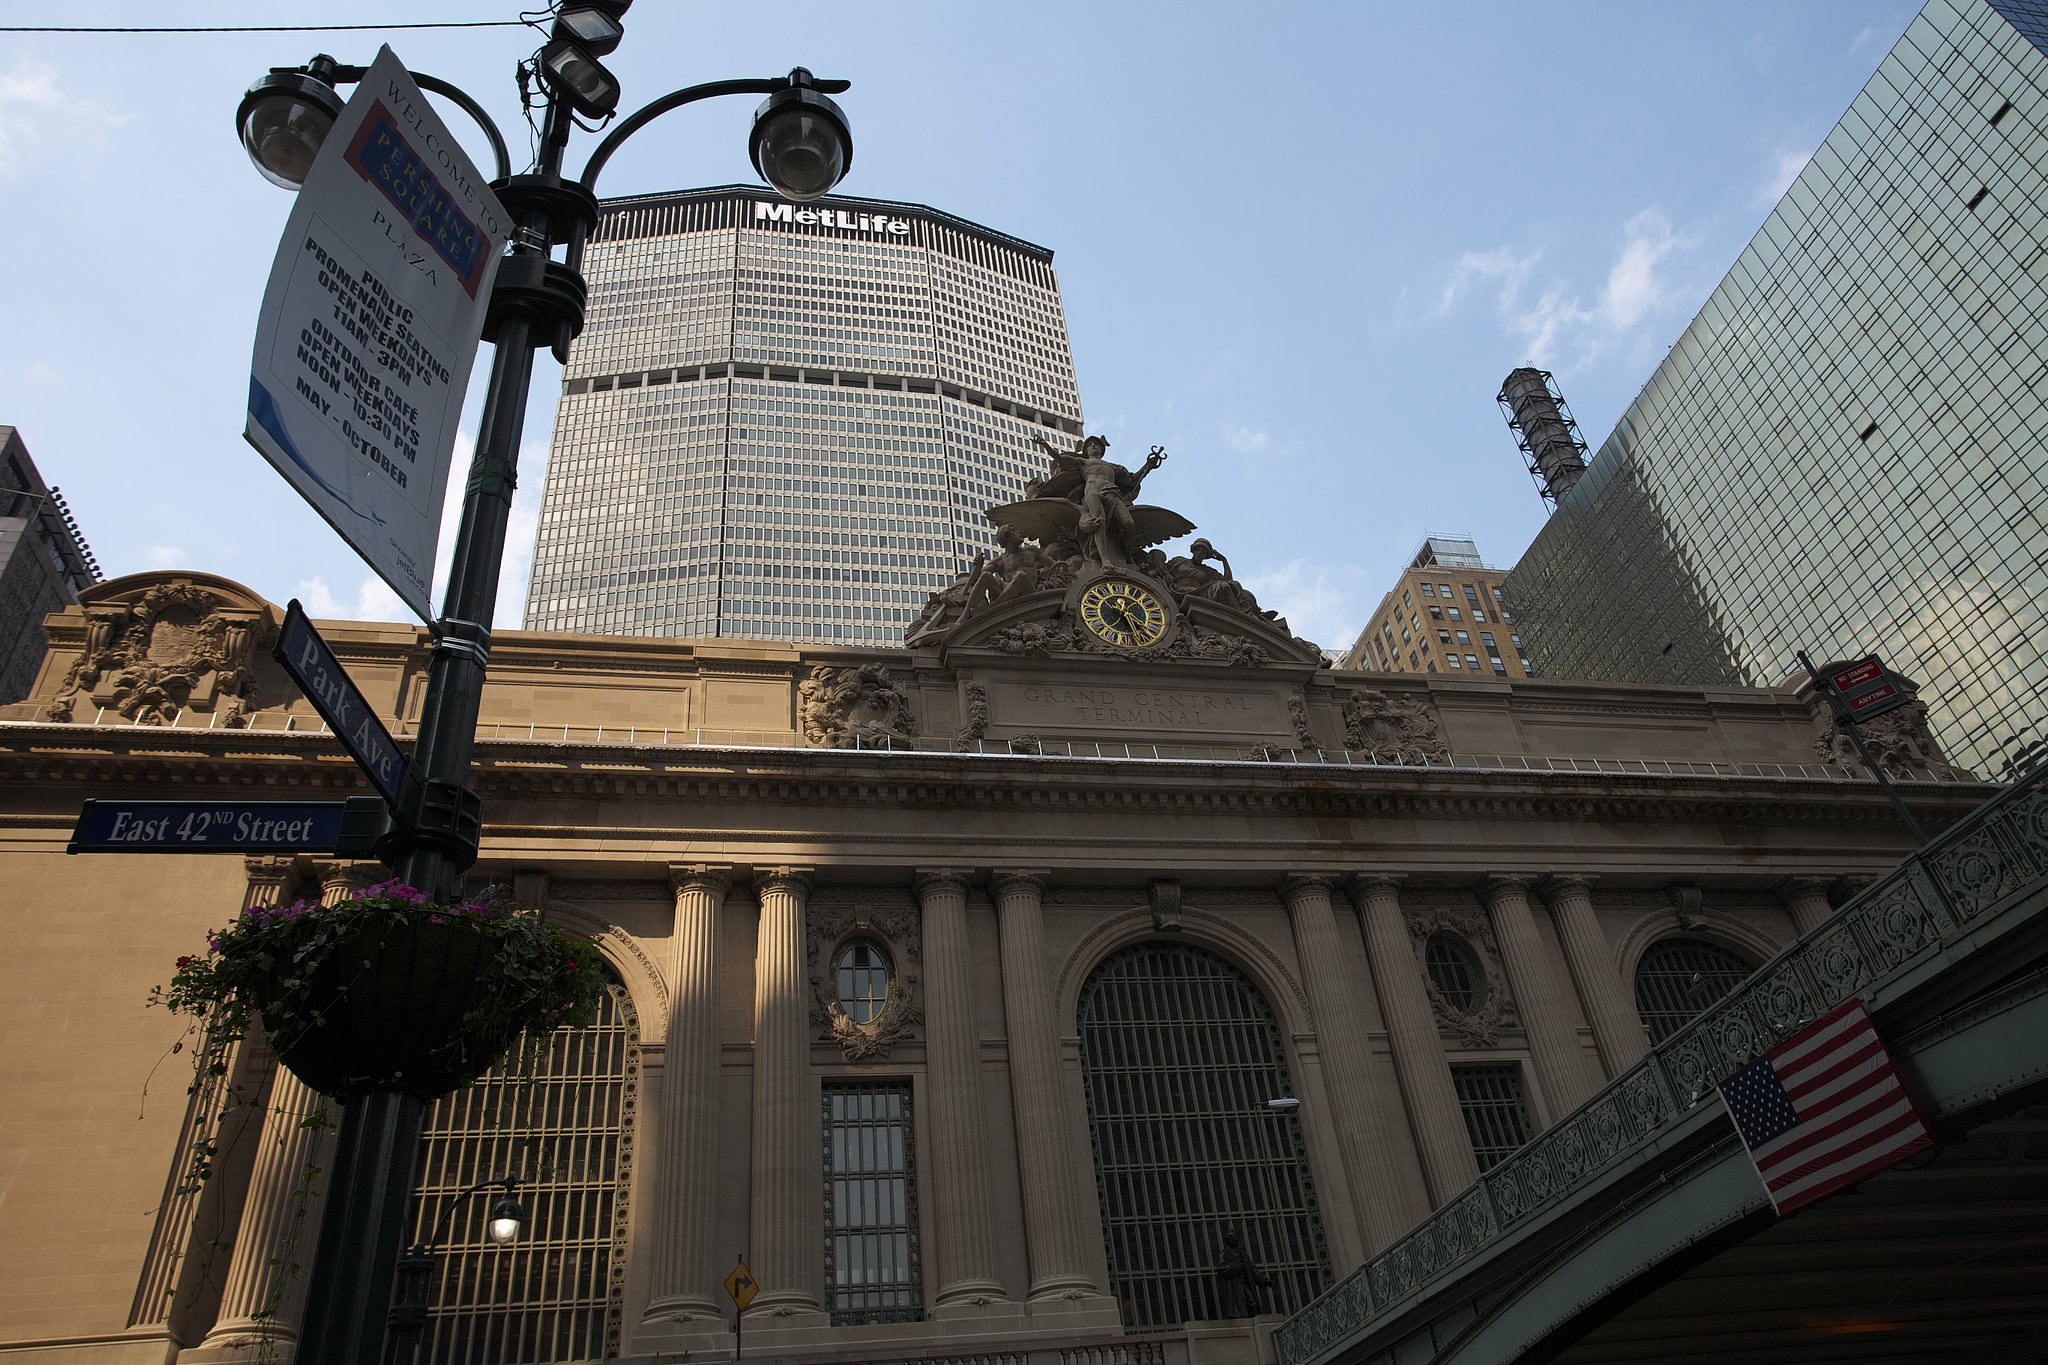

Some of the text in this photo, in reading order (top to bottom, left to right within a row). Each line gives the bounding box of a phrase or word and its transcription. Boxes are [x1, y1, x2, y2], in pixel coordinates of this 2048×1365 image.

[377, 131, 477, 254] PERSHING
[387, 79, 498, 234] WELCOME TO
[372, 209, 437, 287] PLAZA
[379, 163, 462, 260] SQUARE
[756, 201, 909, 235] MetLife
[305, 236, 450, 385] PROMENADE SEATING
[317, 269, 432, 386] OPEN WEEKDAYS
[333, 304, 370, 349] 11AM
[377, 350, 412, 387] 3PM
[361, 270, 414, 325] PUBLIC
[296, 343, 341, 394] NOON
[352, 396, 392, 441] 10:30
[394, 434, 417, 465] PM
[301, 328, 420, 446] OPEN WEEKDAYS
[311, 318, 419, 426] OUTDOOR CAFÉ
[296, 375, 331, 416] MAY
[342, 419, 408, 489] OCTOBER
[297, 634, 392, 782] Park Ave
[1024, 688, 1252, 711] GRAND CENTRAL
[1077, 706, 1207, 725] TERMINAL
[1847, 663, 1874, 679] STANDING
[1858, 689, 1888, 705] ANYTIME
[107, 810, 314, 843] East 42ND Street
